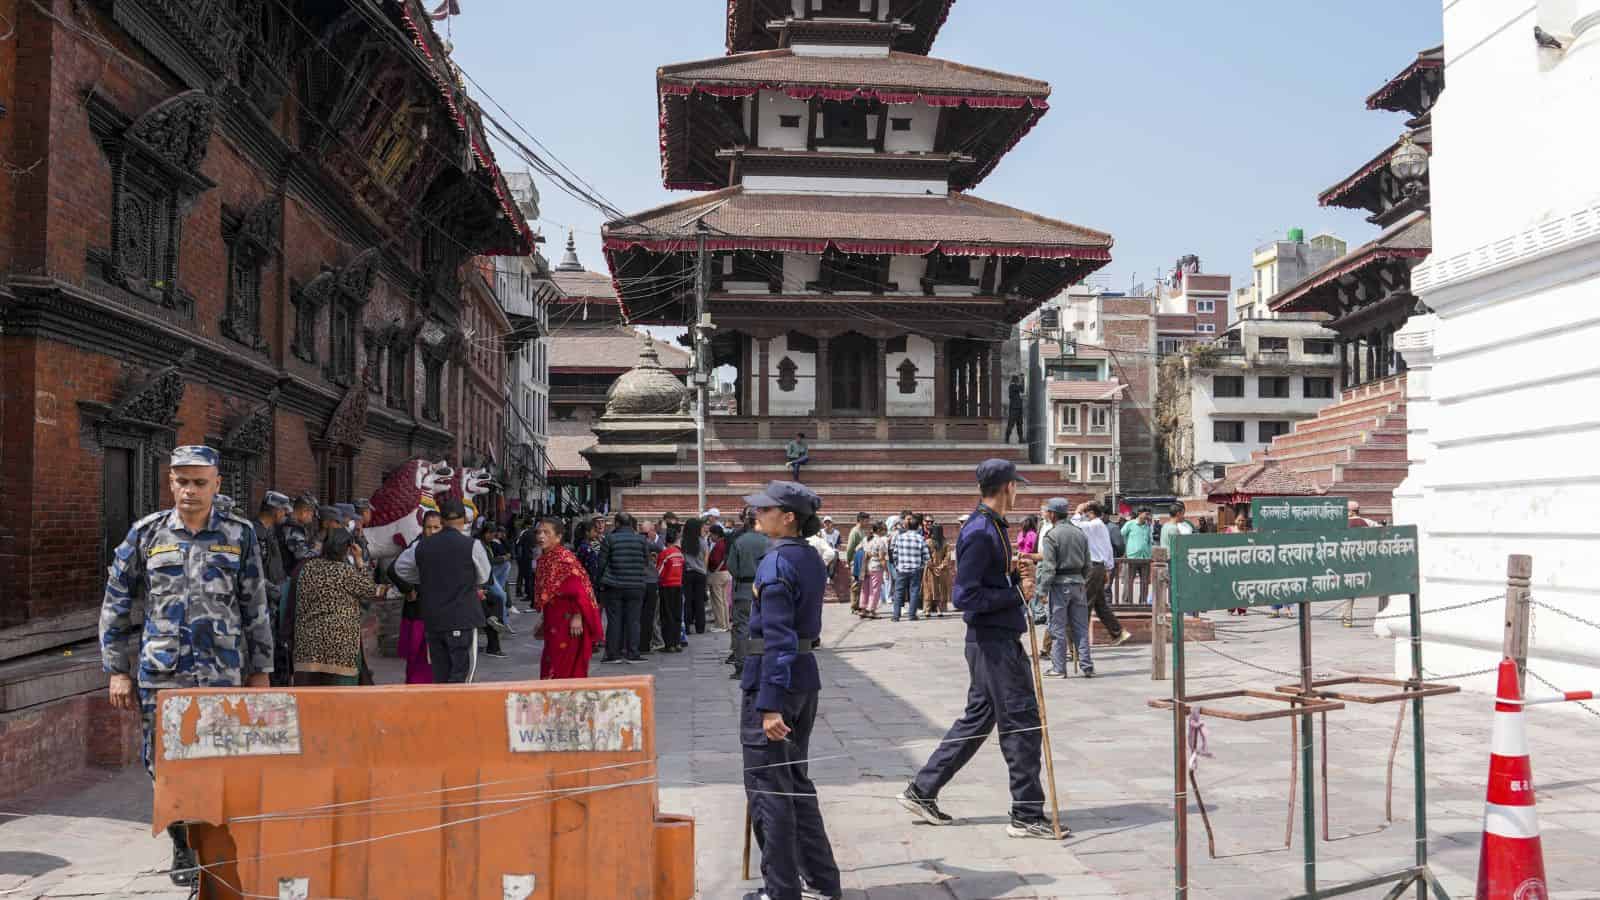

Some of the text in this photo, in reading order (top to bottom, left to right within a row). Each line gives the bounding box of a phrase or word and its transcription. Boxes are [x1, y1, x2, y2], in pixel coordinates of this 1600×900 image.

[1315, 536, 1339, 566] क्षेत्र
[1340, 537, 1378, 562] संरक्षण
[1312, 568, 1340, 594] लागि
[519, 728, 580, 742] WATER
